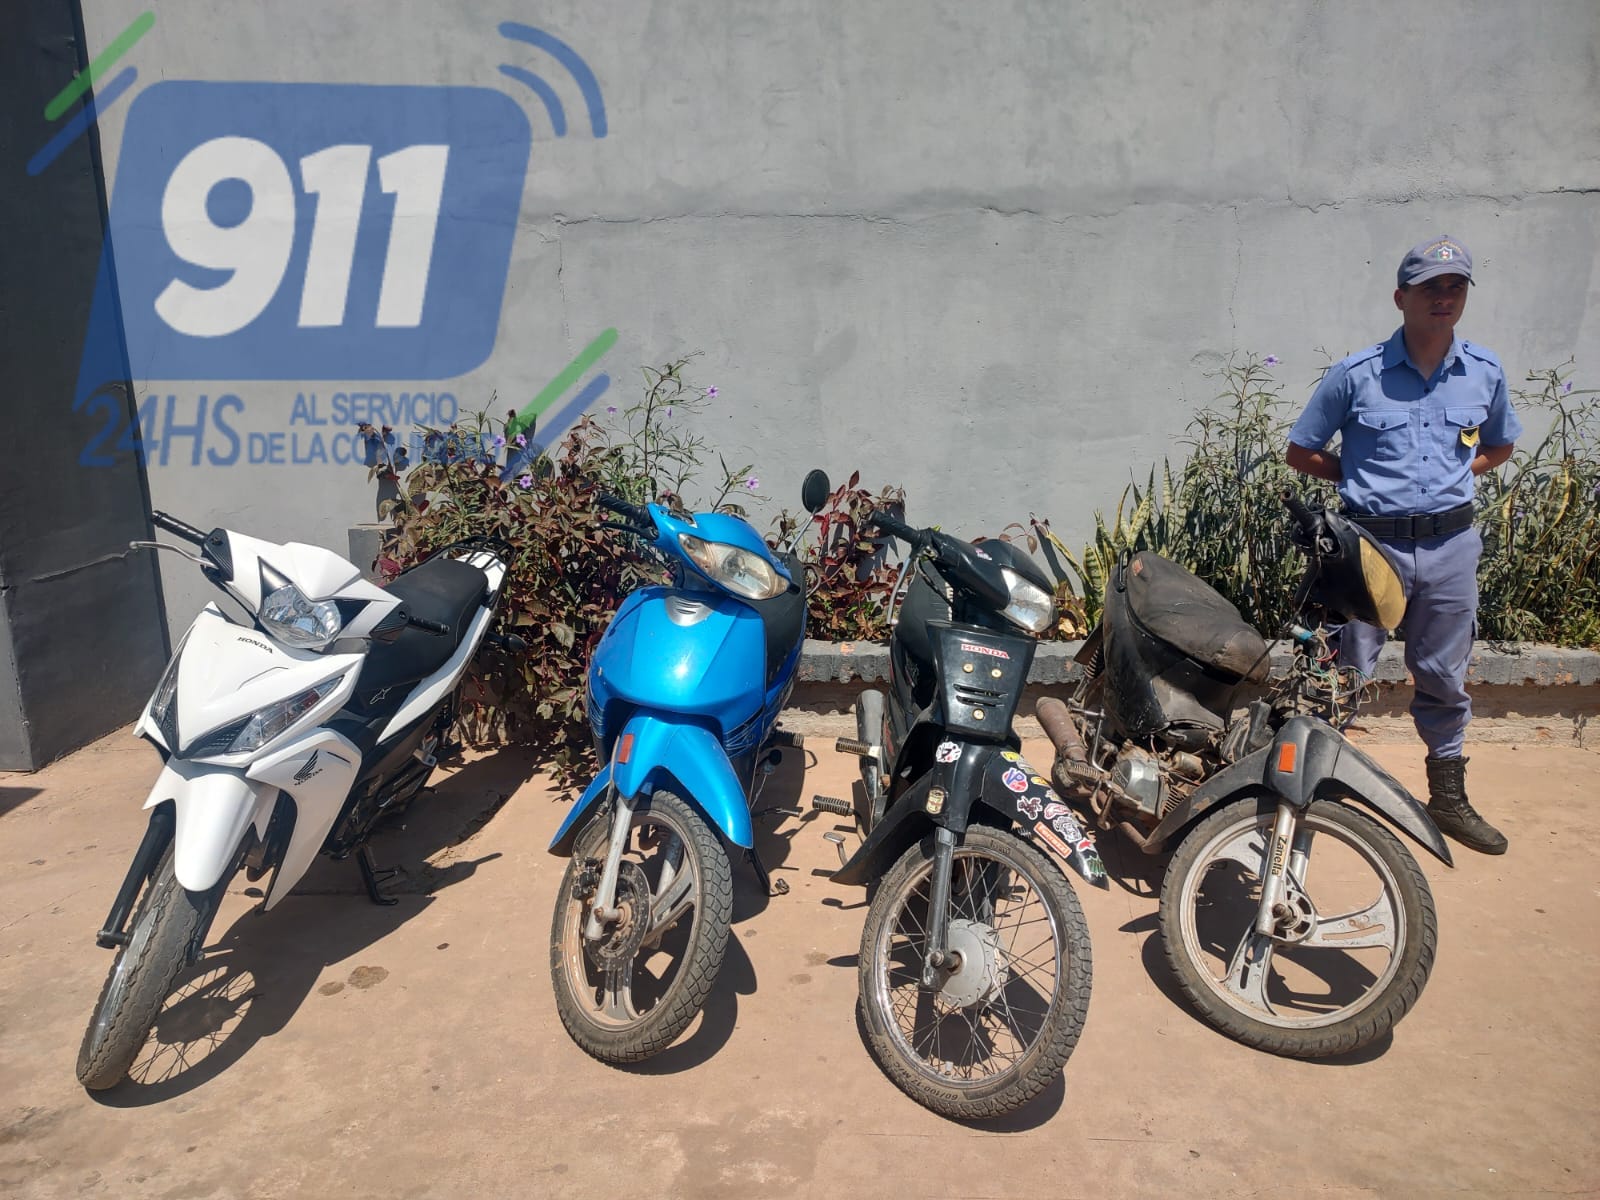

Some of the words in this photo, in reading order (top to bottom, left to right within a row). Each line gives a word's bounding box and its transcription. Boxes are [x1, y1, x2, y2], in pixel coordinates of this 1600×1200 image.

[237, 636, 273, 654] HONDA
[961, 643, 1010, 659] HONDA
[1271, 835, 1288, 876] Zanella
